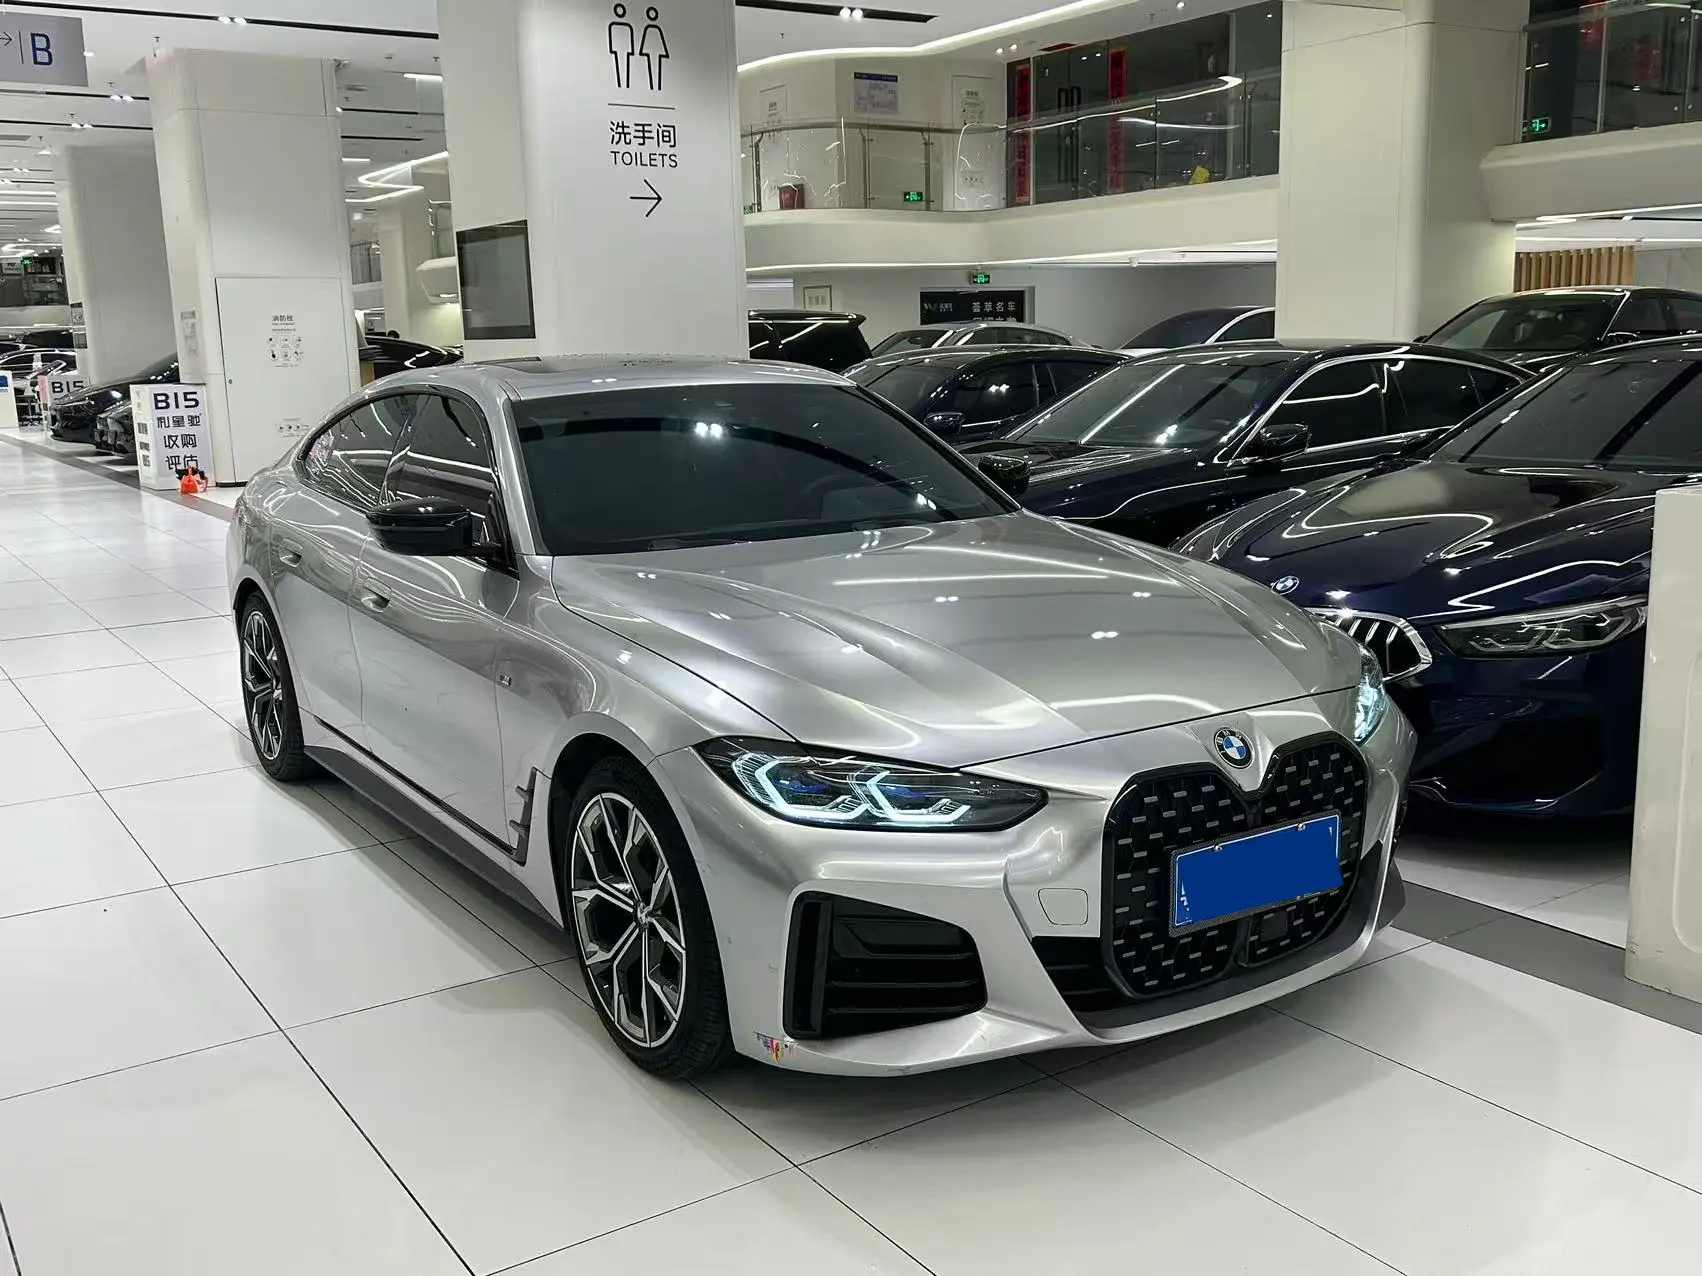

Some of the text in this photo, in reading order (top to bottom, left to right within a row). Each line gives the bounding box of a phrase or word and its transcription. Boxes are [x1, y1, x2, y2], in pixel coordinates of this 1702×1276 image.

[30, 32, 53, 66] B
[610, 120, 677, 148] 洗手间
[610, 150, 678, 168] TOILETS
[163, 433, 197, 449] 收购
[165, 455, 199, 471] 评估
